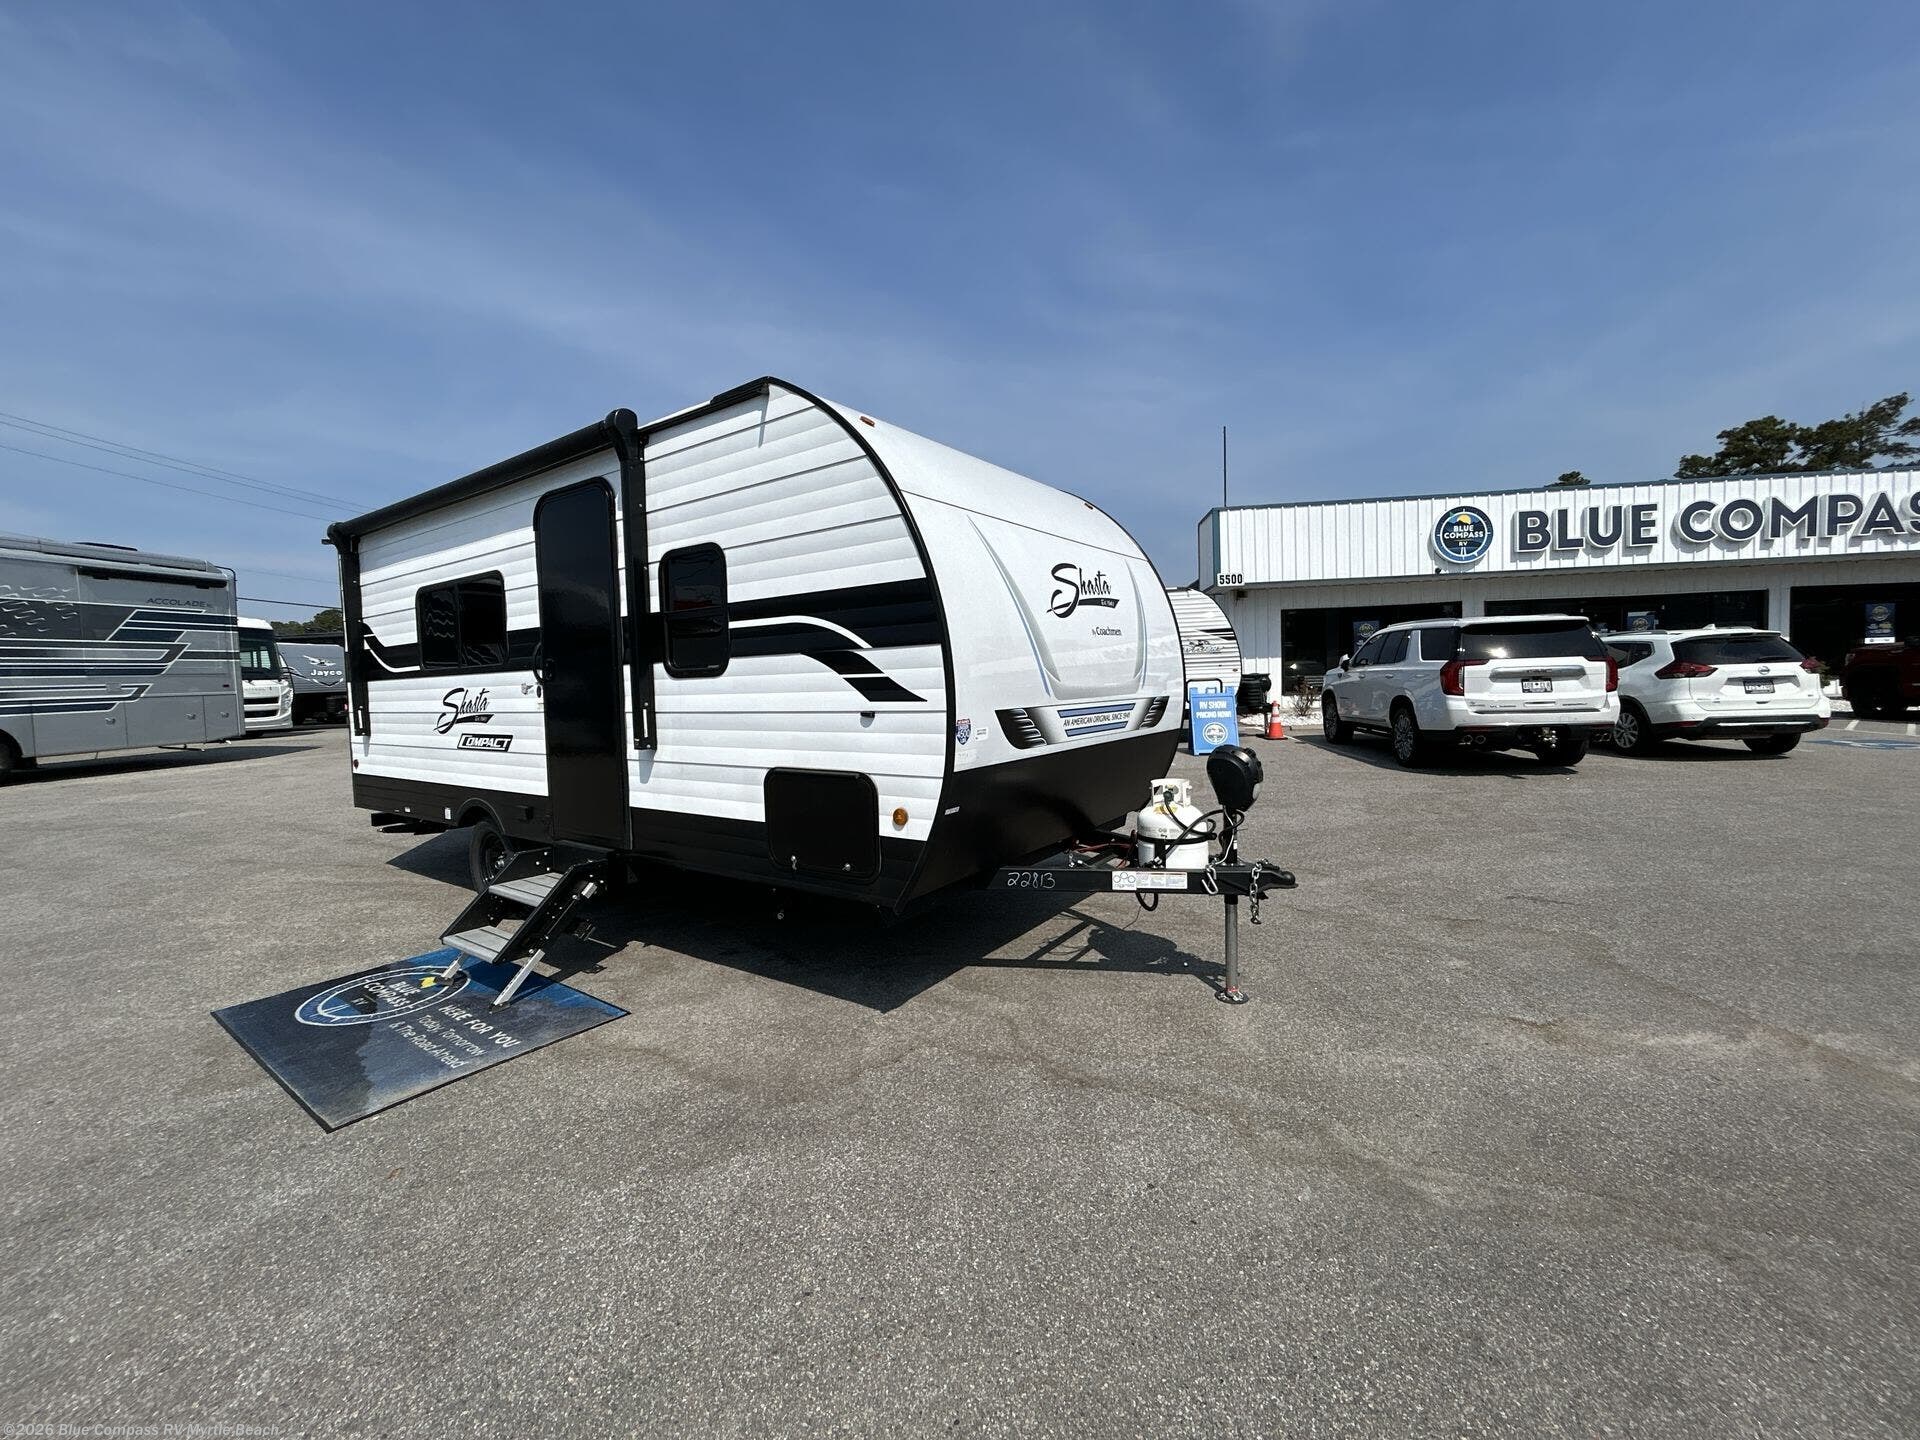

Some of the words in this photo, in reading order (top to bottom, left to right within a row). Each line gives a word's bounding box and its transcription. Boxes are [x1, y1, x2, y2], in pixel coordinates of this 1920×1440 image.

[1516, 502, 1658, 552] BLUE
[1443, 531, 1484, 539] COMPASS
[1219, 573, 1243, 585] 5500
[1046, 563, 1113, 618] Shasta
[146, 598, 207, 607] ACCOLADE
[1096, 626, 1121, 636] Coachmen
[311, 669, 343, 677] Jayco
[433, 687, 490, 734] Shasta
[1199, 701, 1208, 709] RV
[1208, 700, 1227, 709] SHOW
[1063, 719, 1070, 727] AN
[1071, 716, 1092, 726] AMERICAN
[1093, 714, 1111, 724] ORIGINAL
[1112, 712, 1123, 721] SINCE
[1196, 710, 1217, 719] PRICING
[458, 734, 511, 751] COMPACT
[1007, 871, 1056, 889] 22813
[363, 981, 412, 1007] COMPASS
[389, 981, 421, 996] BLUE
[389, 1021, 406, 1029] &
[395, 1024, 416, 1038] The
[438, 1004, 473, 1021] HERE
[463, 1019, 494, 1035] FOR
[488, 1031, 521, 1048] YOU
[411, 1034, 441, 1051] Road
[440, 1028, 488, 1056] Tomorrow
[430, 1047, 469, 1069] Ahead
